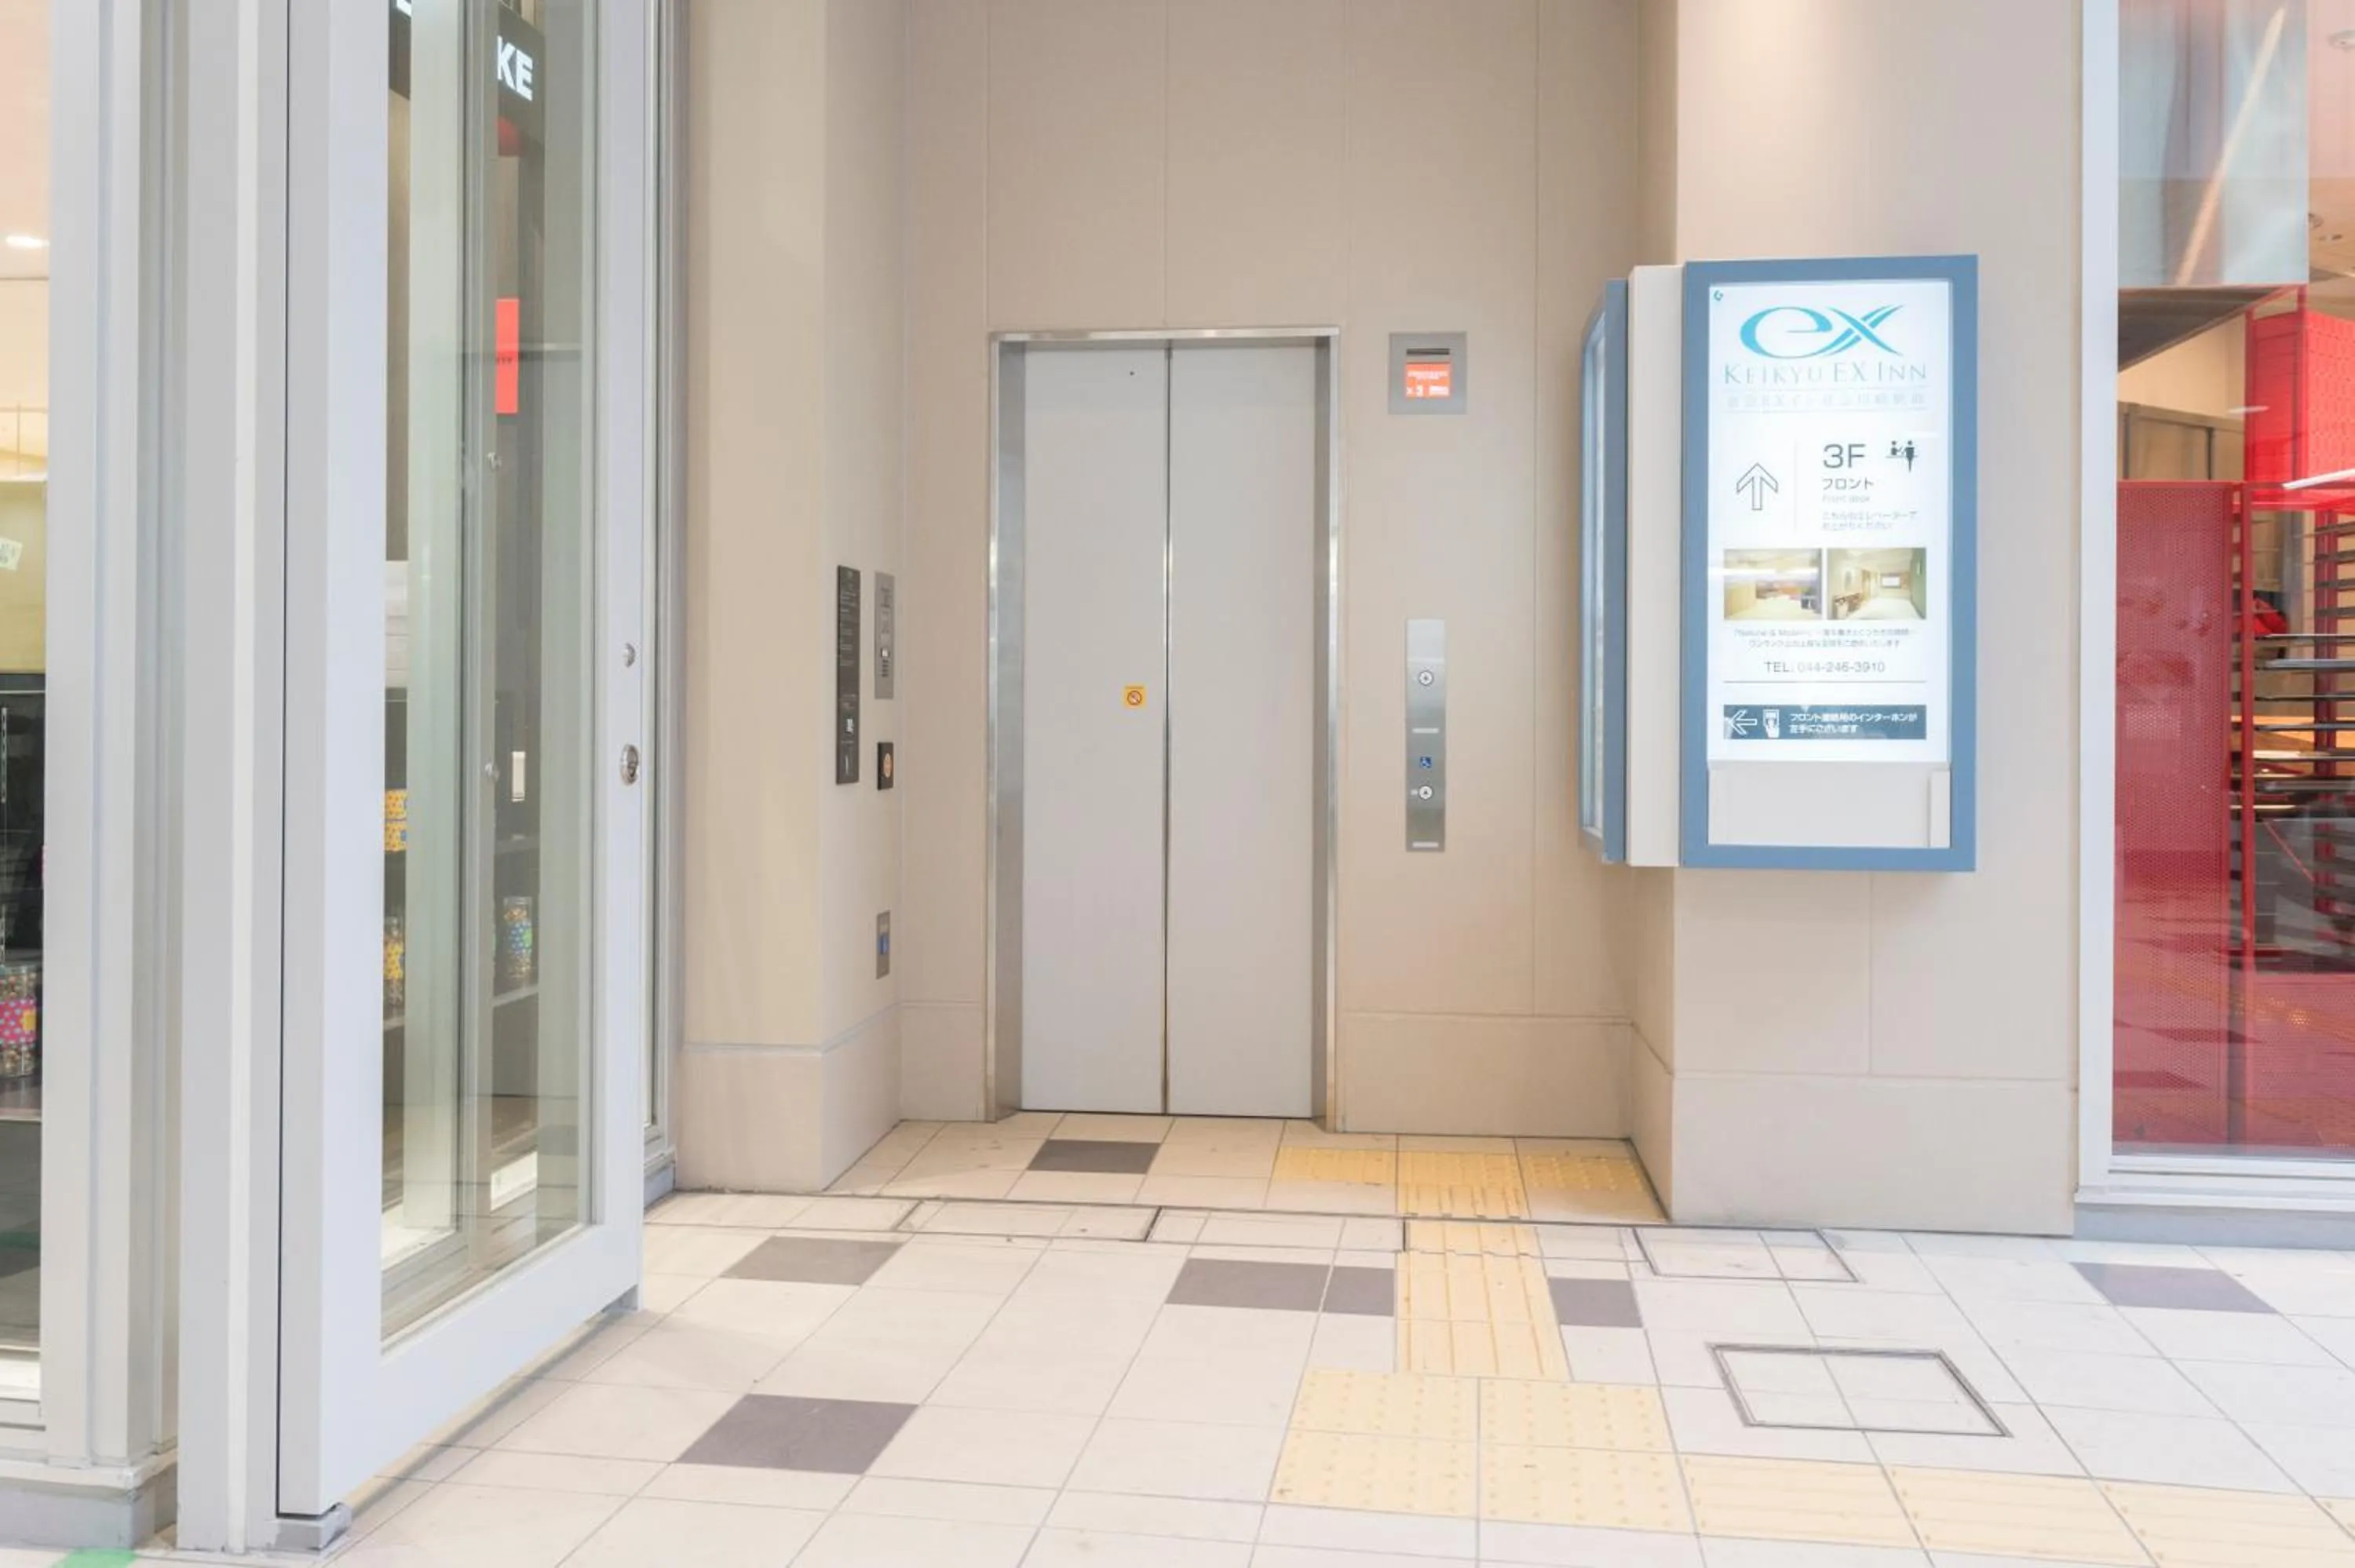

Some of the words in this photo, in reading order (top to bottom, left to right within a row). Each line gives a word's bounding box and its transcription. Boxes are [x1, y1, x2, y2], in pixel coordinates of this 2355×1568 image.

[1725, 361, 1822, 385] KEIKYU
[1833, 360, 1867, 382] EX
[1877, 360, 1926, 381] INN
[1824, 443, 1866, 469] 3F
[1822, 477, 1875, 490] フロント
